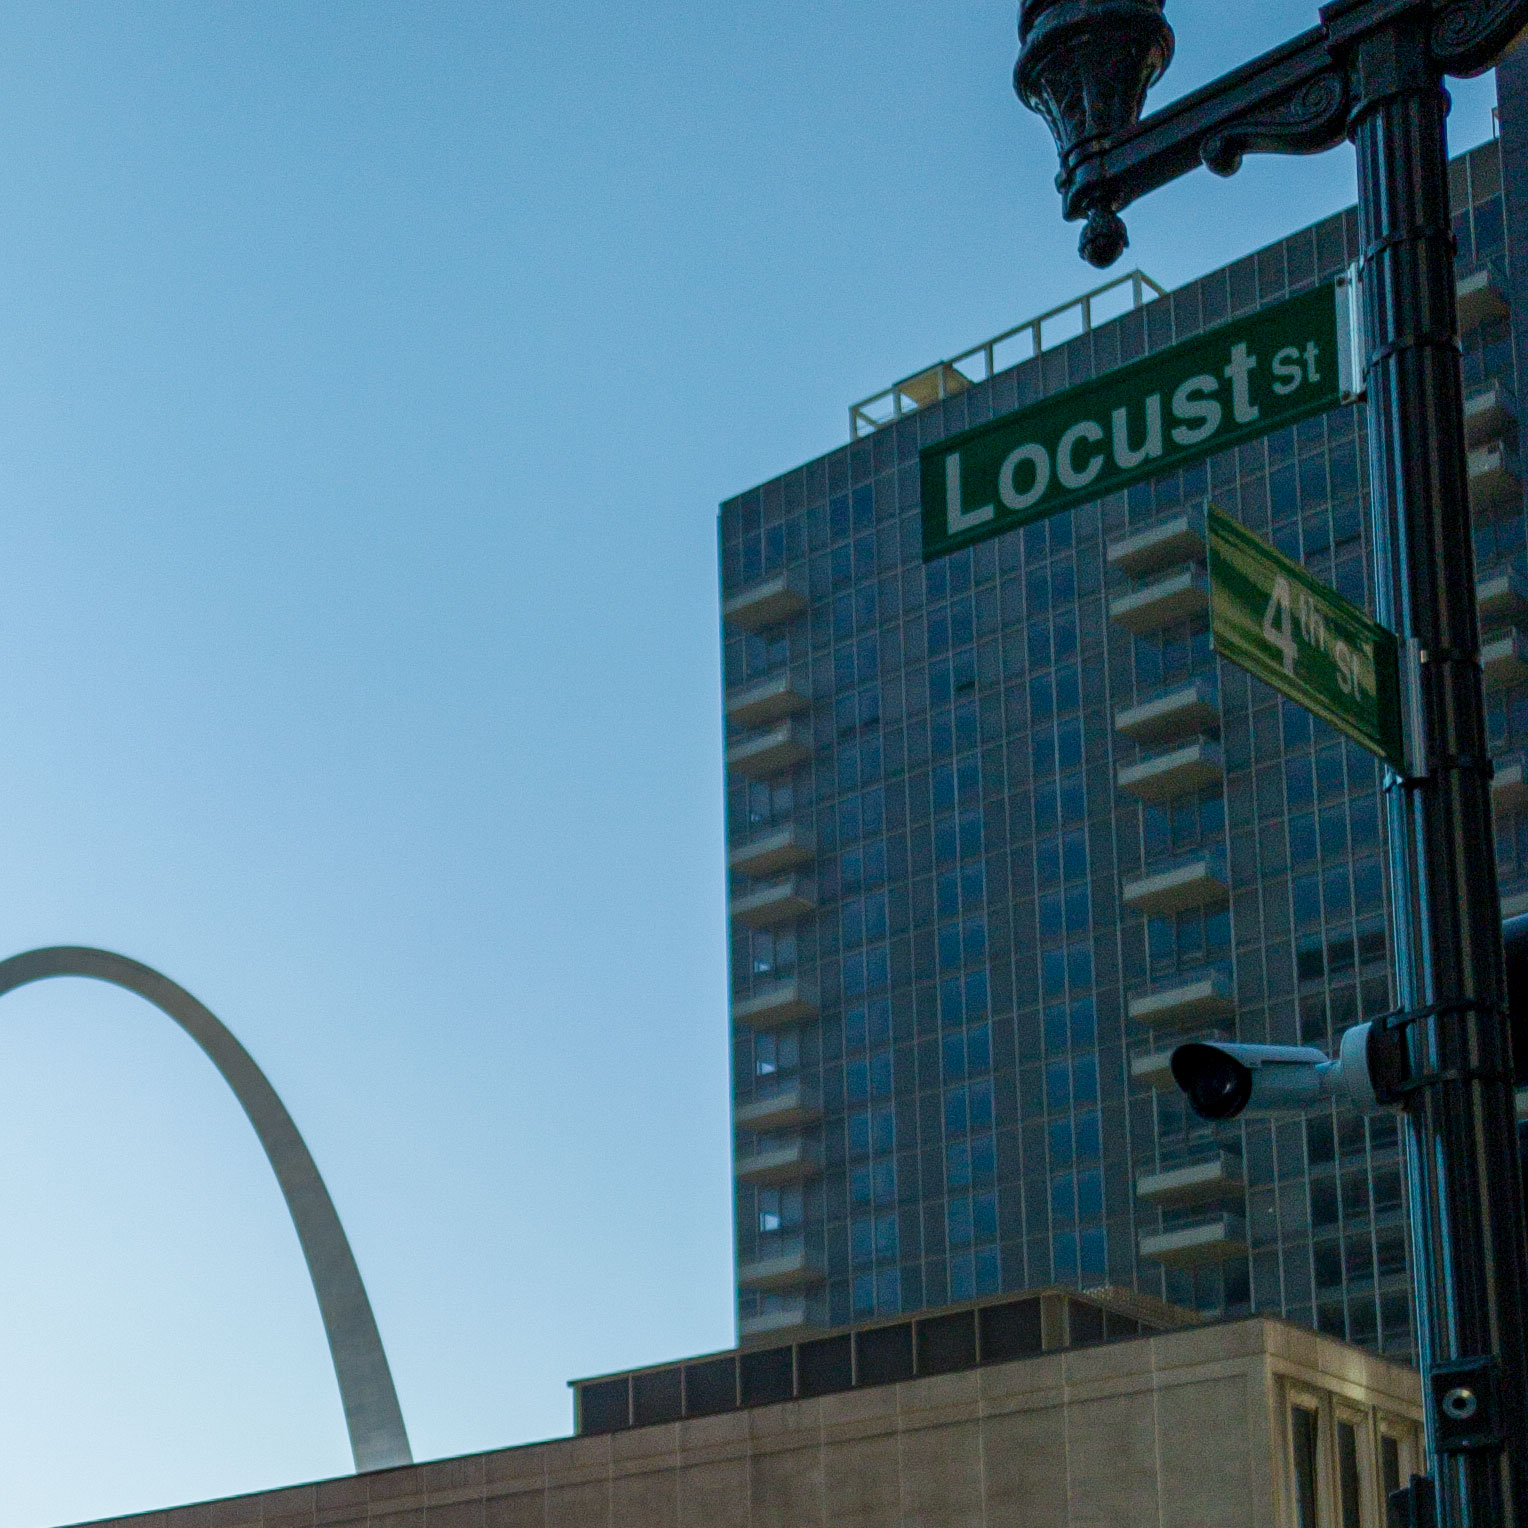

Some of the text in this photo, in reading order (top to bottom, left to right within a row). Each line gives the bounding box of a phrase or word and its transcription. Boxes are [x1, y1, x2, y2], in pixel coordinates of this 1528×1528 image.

[945, 340, 1321, 536] Locust St
[1263, 575, 1363, 703] 4th St
